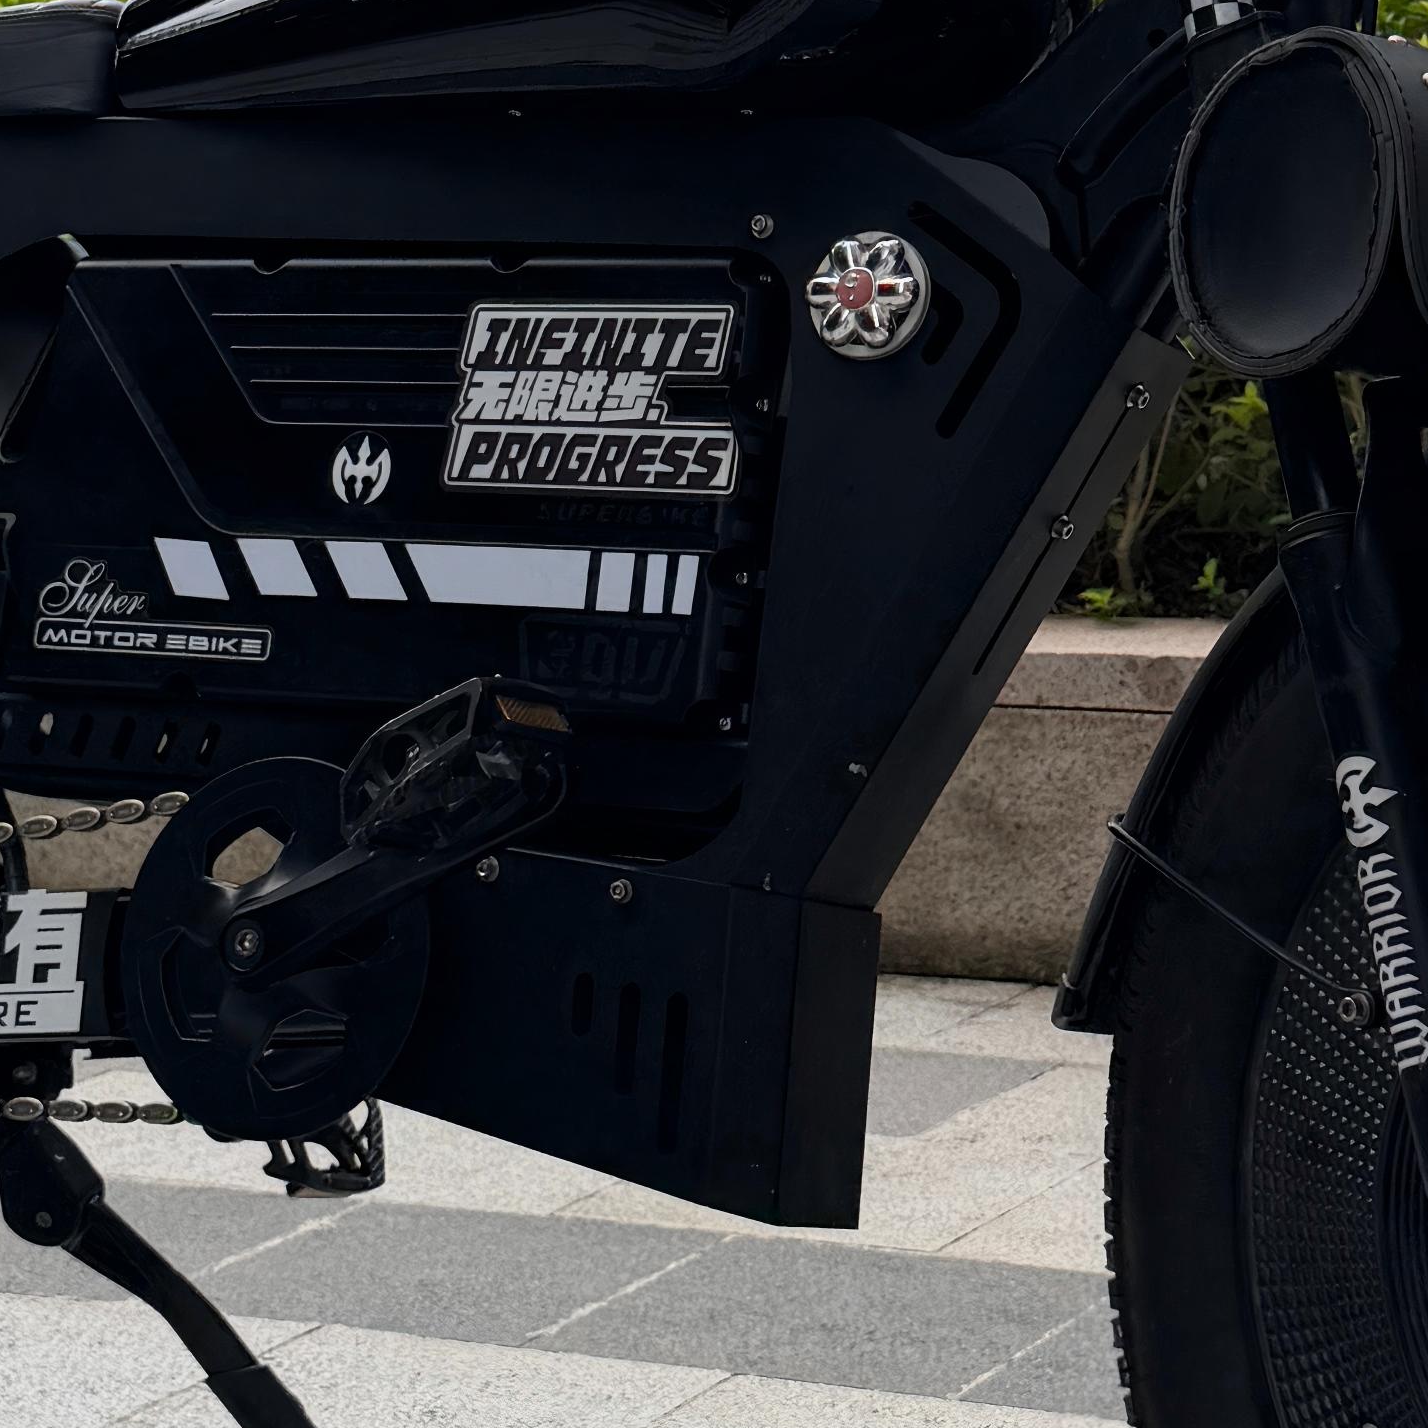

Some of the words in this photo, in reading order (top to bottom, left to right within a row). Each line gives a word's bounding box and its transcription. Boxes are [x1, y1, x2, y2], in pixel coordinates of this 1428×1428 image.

[477, 318, 721, 368] INFINITE
[459, 431, 731, 487] PROGRESS
[39, 560, 146, 628] Super
[42, 628, 158, 649] MOTOR
[166, 634, 262, 655] EBIKE
